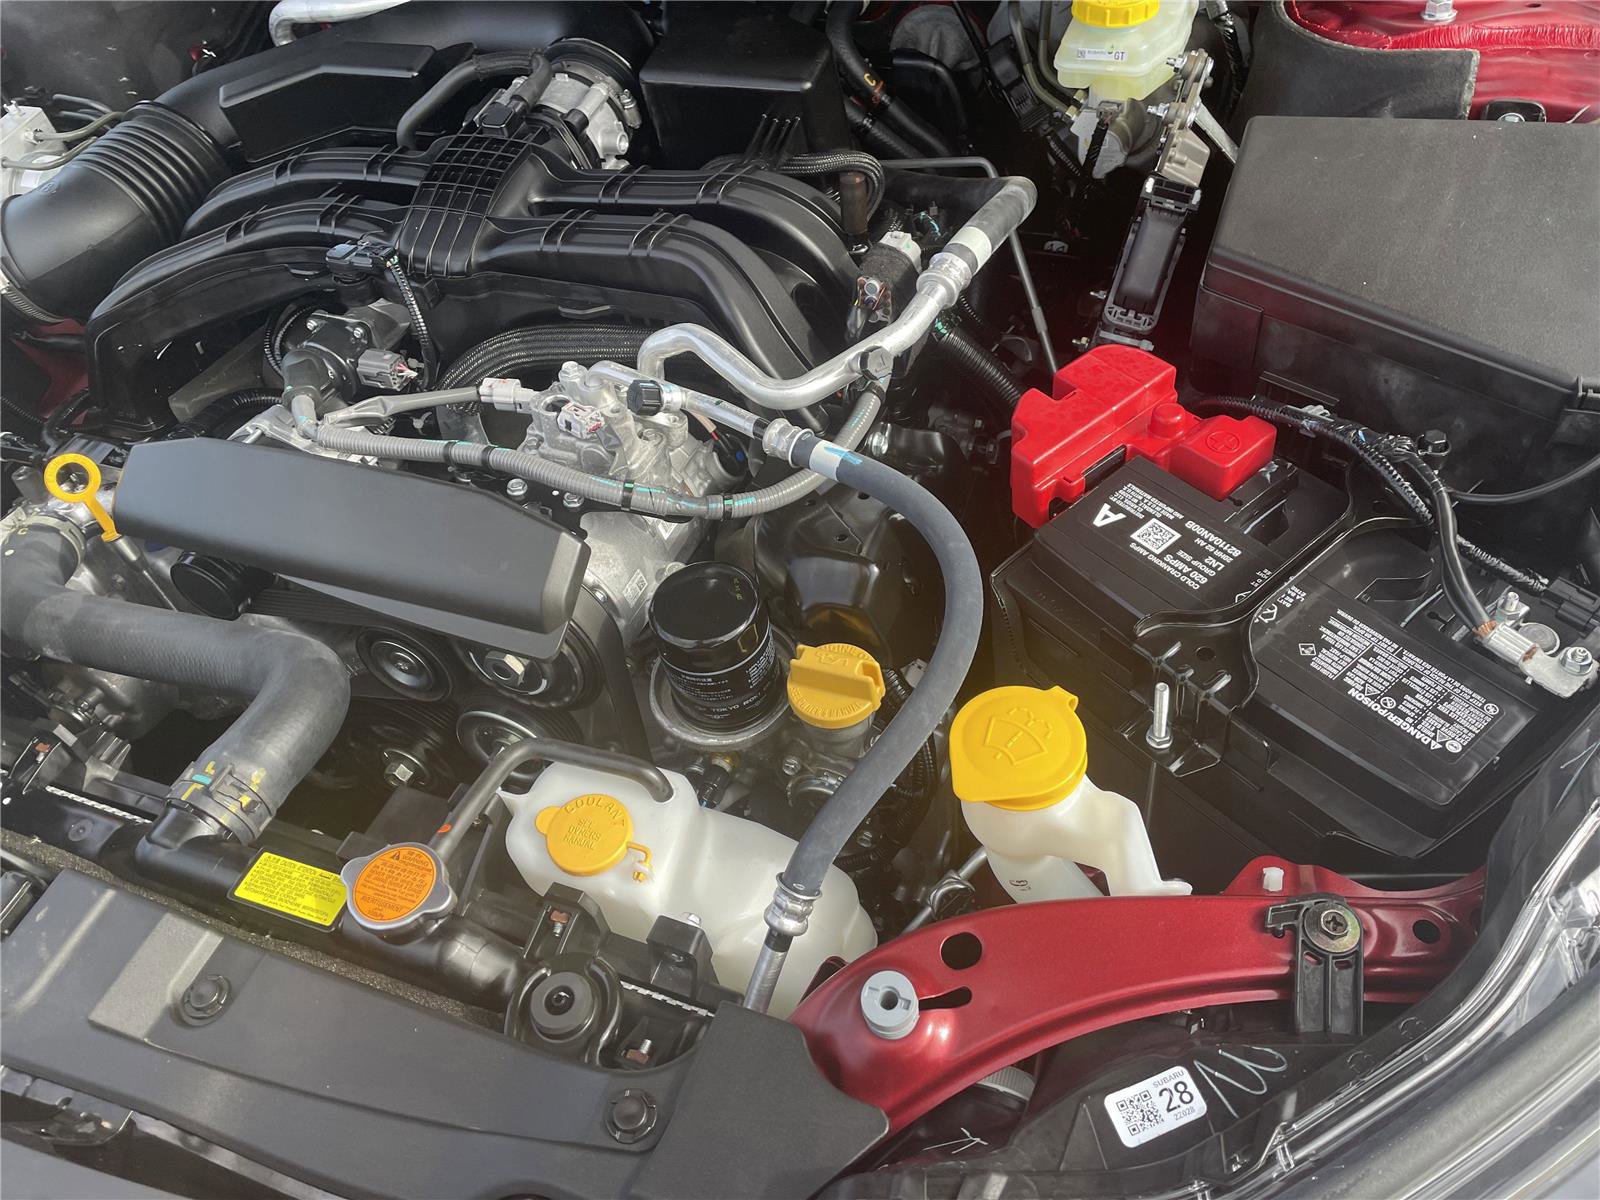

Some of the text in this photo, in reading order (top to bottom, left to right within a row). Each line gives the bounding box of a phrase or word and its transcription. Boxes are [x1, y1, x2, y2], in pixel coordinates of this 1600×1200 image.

[1126, 481, 1184, 520] AND IMPORTED MATERIALS
[1158, 508, 1175, 520] MADE
[1088, 502, 1126, 534] A
[1183, 519, 1242, 557] 82110AN00B
[1193, 536, 1234, 563] 20HR 62 AH
[1128, 541, 1201, 589] COLD CRANKING AMPS
[1162, 553, 1209, 584] 620 AMPS
[1175, 549, 1217, 576] GROUP SIZE
[1202, 555, 1225, 570] LN2
[1346, 686, 1432, 745] DANGER/POISON
[564, 796, 625, 827] COOLANT
[1153, 1070, 1185, 1088] SUBARU
